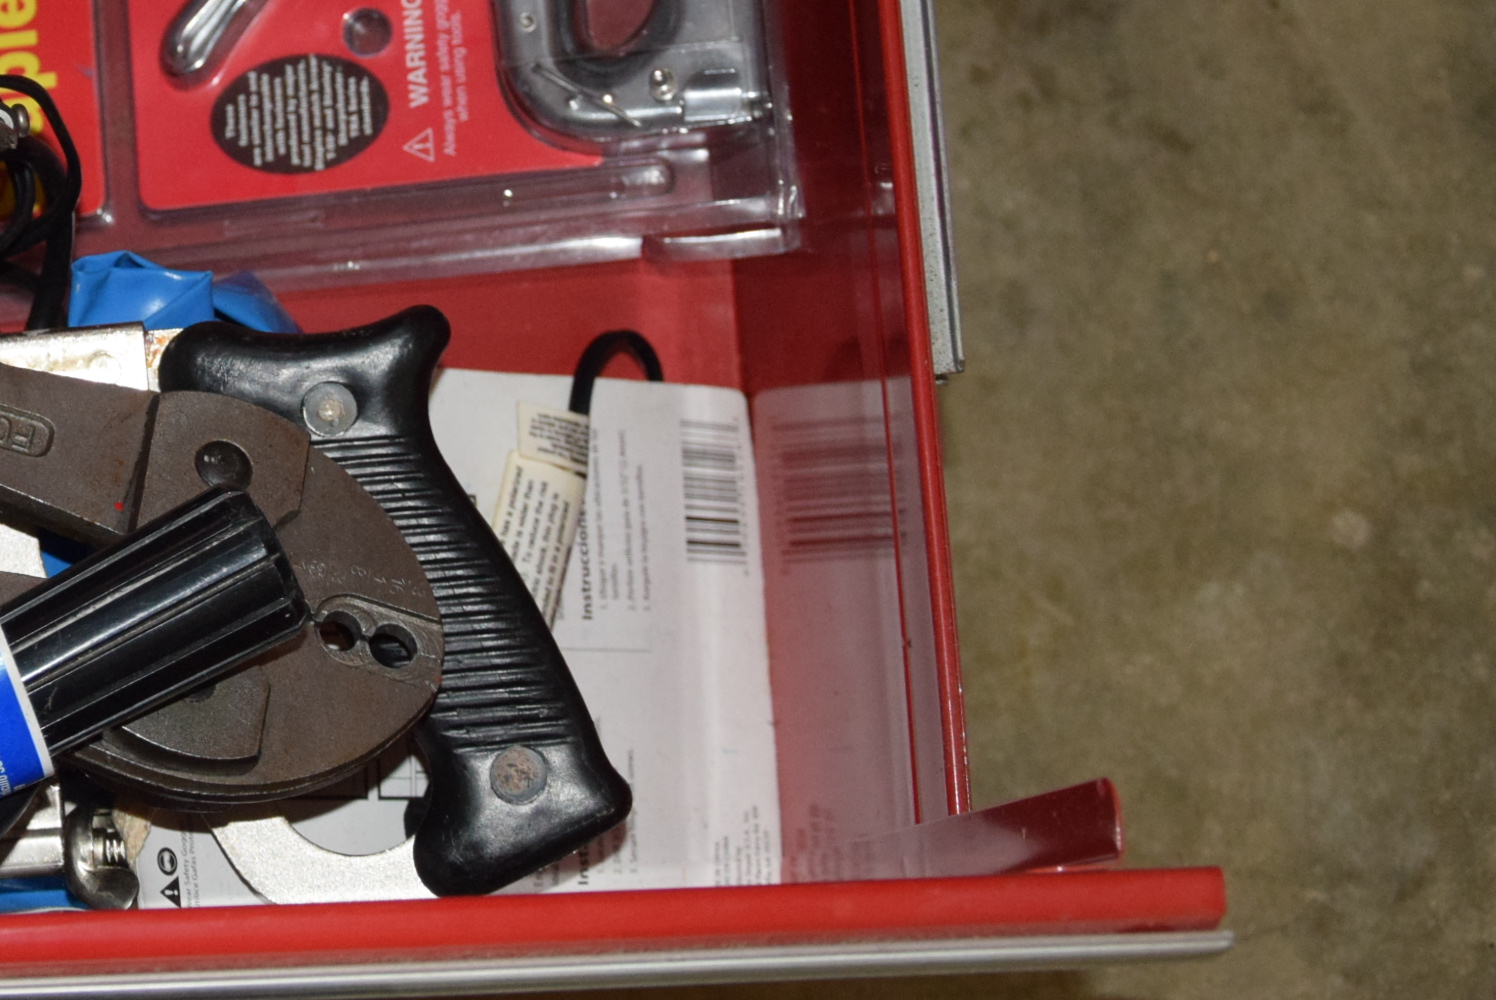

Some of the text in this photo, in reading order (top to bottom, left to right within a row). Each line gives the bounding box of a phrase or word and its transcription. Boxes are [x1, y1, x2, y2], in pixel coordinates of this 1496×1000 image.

[436, 33, 453, 71] safety
[449, 11, 470, 121] when using tools.
[438, 76, 454, 106] wear
[441, 110, 458, 156] Always
[181, 859, 190, 885] Safety
